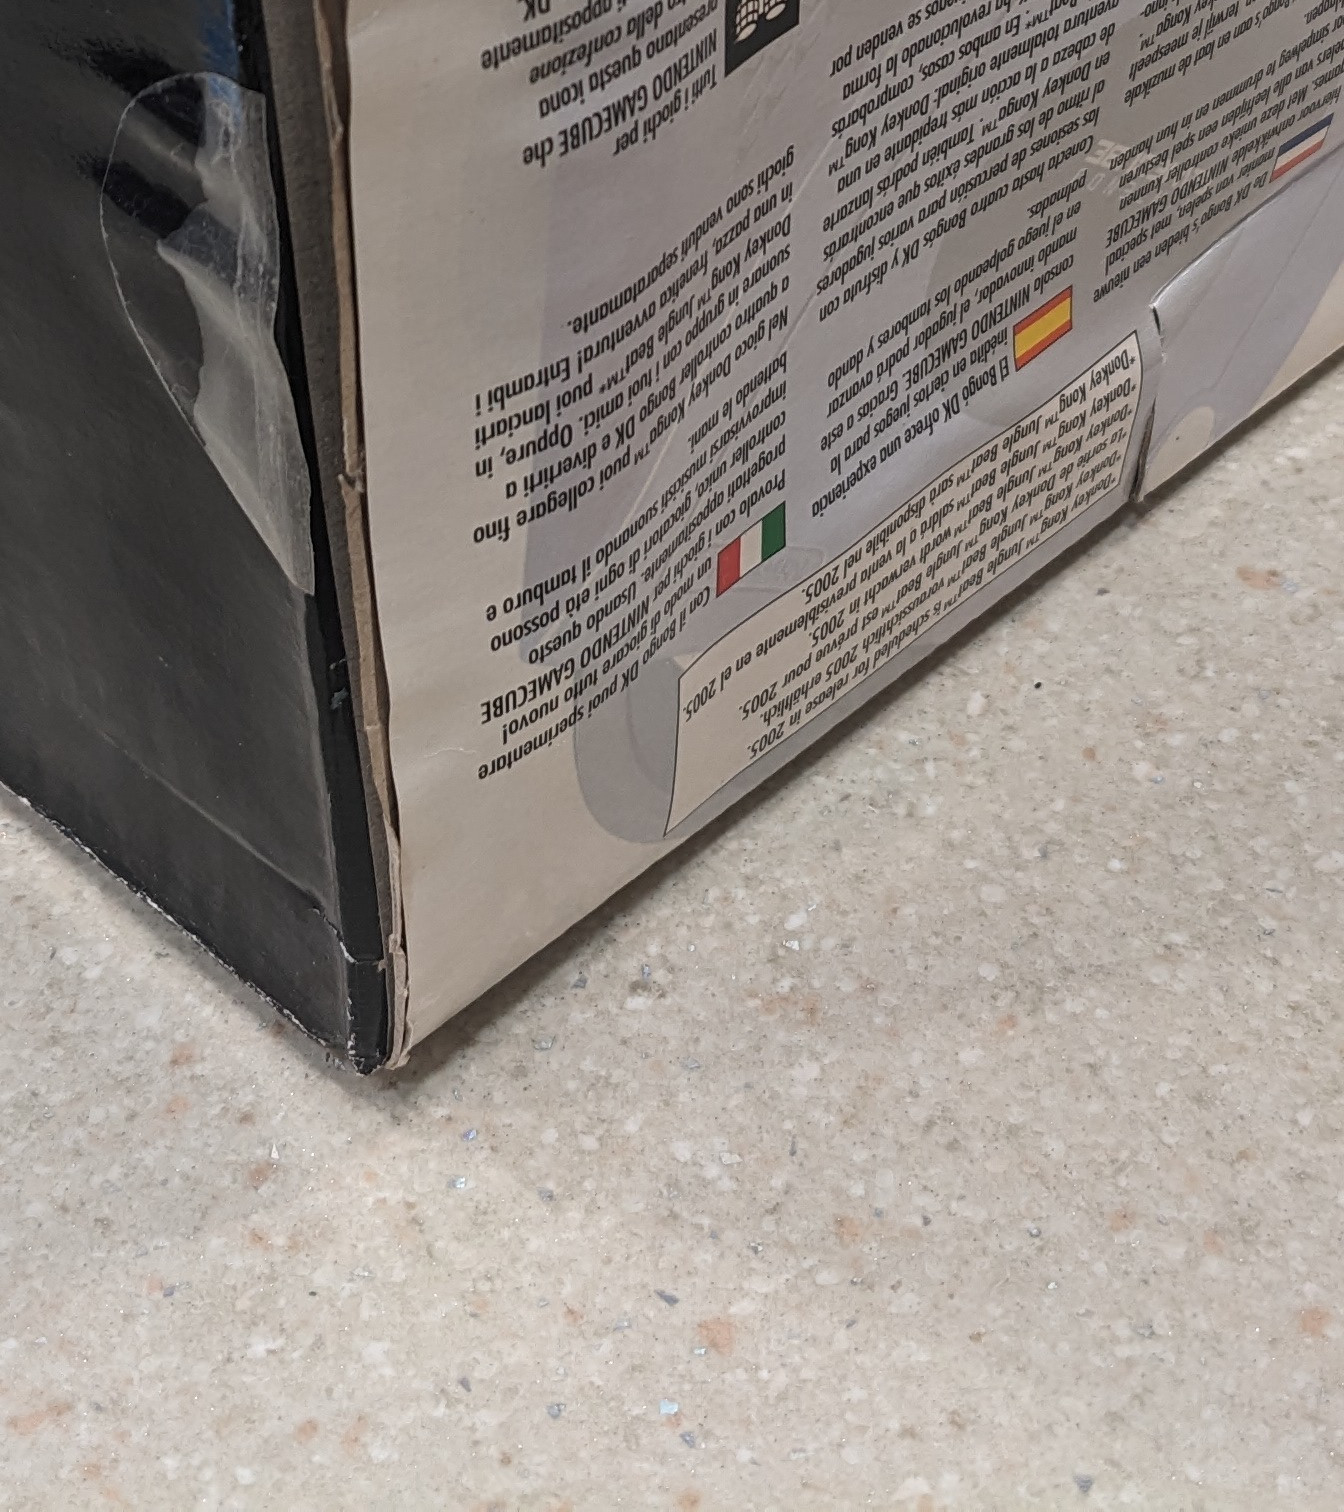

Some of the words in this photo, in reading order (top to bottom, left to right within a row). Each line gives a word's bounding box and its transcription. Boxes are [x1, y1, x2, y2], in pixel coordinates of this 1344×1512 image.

[755, 143, 794, 195] giochi
[725, 177, 754, 214] sono
[680, 205, 723, 256] venduti
[960, 363, 997, 407] Bongó
[998, 354, 1010, 382] El
[903, 406, 940, 444] ofrece
[940, 391, 960, 423] DK
[878, 434, 902, 464] una
[811, 453, 877, 518] experiencia
[985, 536, 1025, 575] Jungle
[678, 606, 687, 630] il
[688, 584, 710, 614] Con
[931, 599, 942, 616] is
[641, 617, 677, 665] Bongo
[871, 608, 931, 669] scheduled
[619, 658, 639, 693] DK
[850, 656, 870, 680] for
[587, 673, 618, 713] puoi
[804, 672, 850, 715] release
[788, 707, 802, 726] in
[477, 703, 584, 780] sperimentare
[746, 719, 786, 760] 2005.
